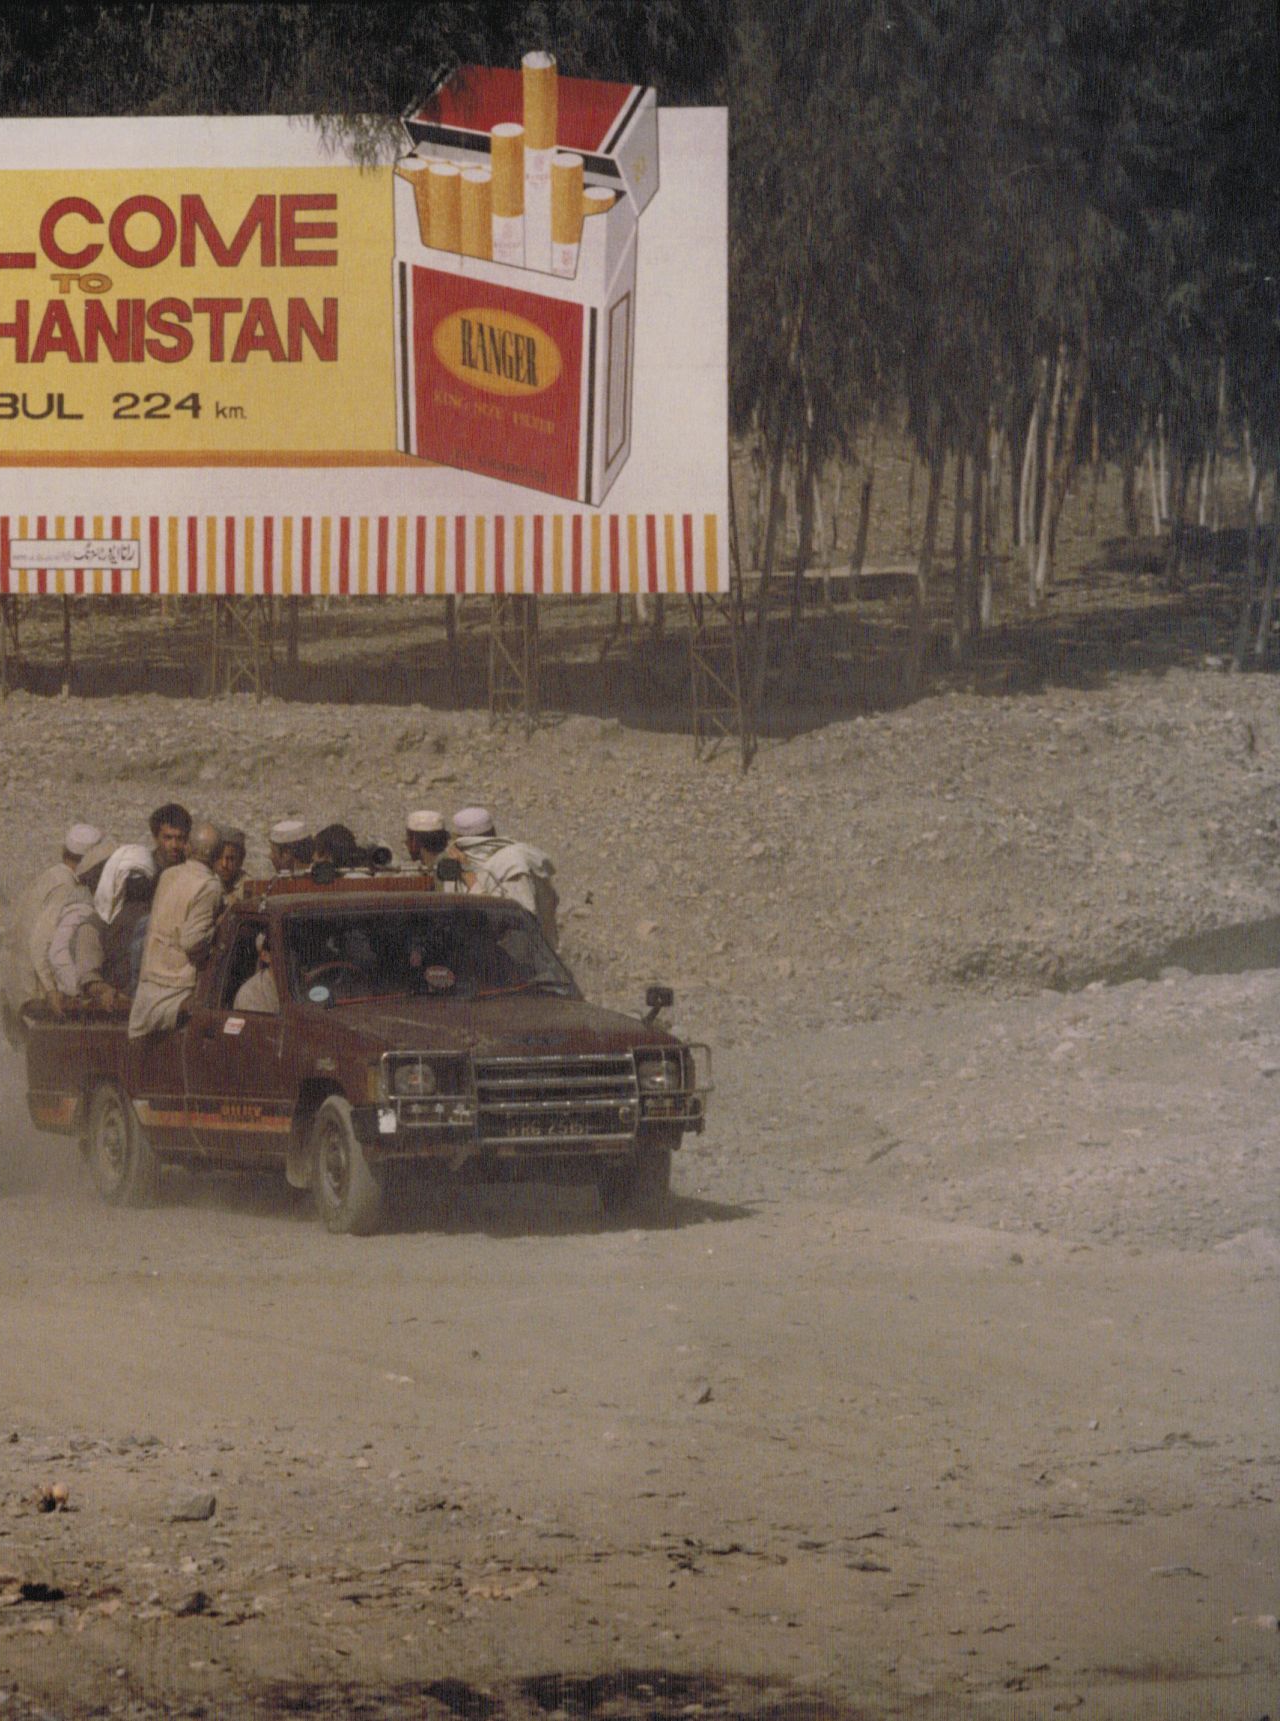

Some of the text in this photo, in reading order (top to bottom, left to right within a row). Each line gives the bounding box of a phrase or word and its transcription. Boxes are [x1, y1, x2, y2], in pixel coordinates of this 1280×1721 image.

[50, 272, 113, 295] TO
[460, 317, 539, 387] RANGER
[112, 392, 203, 420] 224
